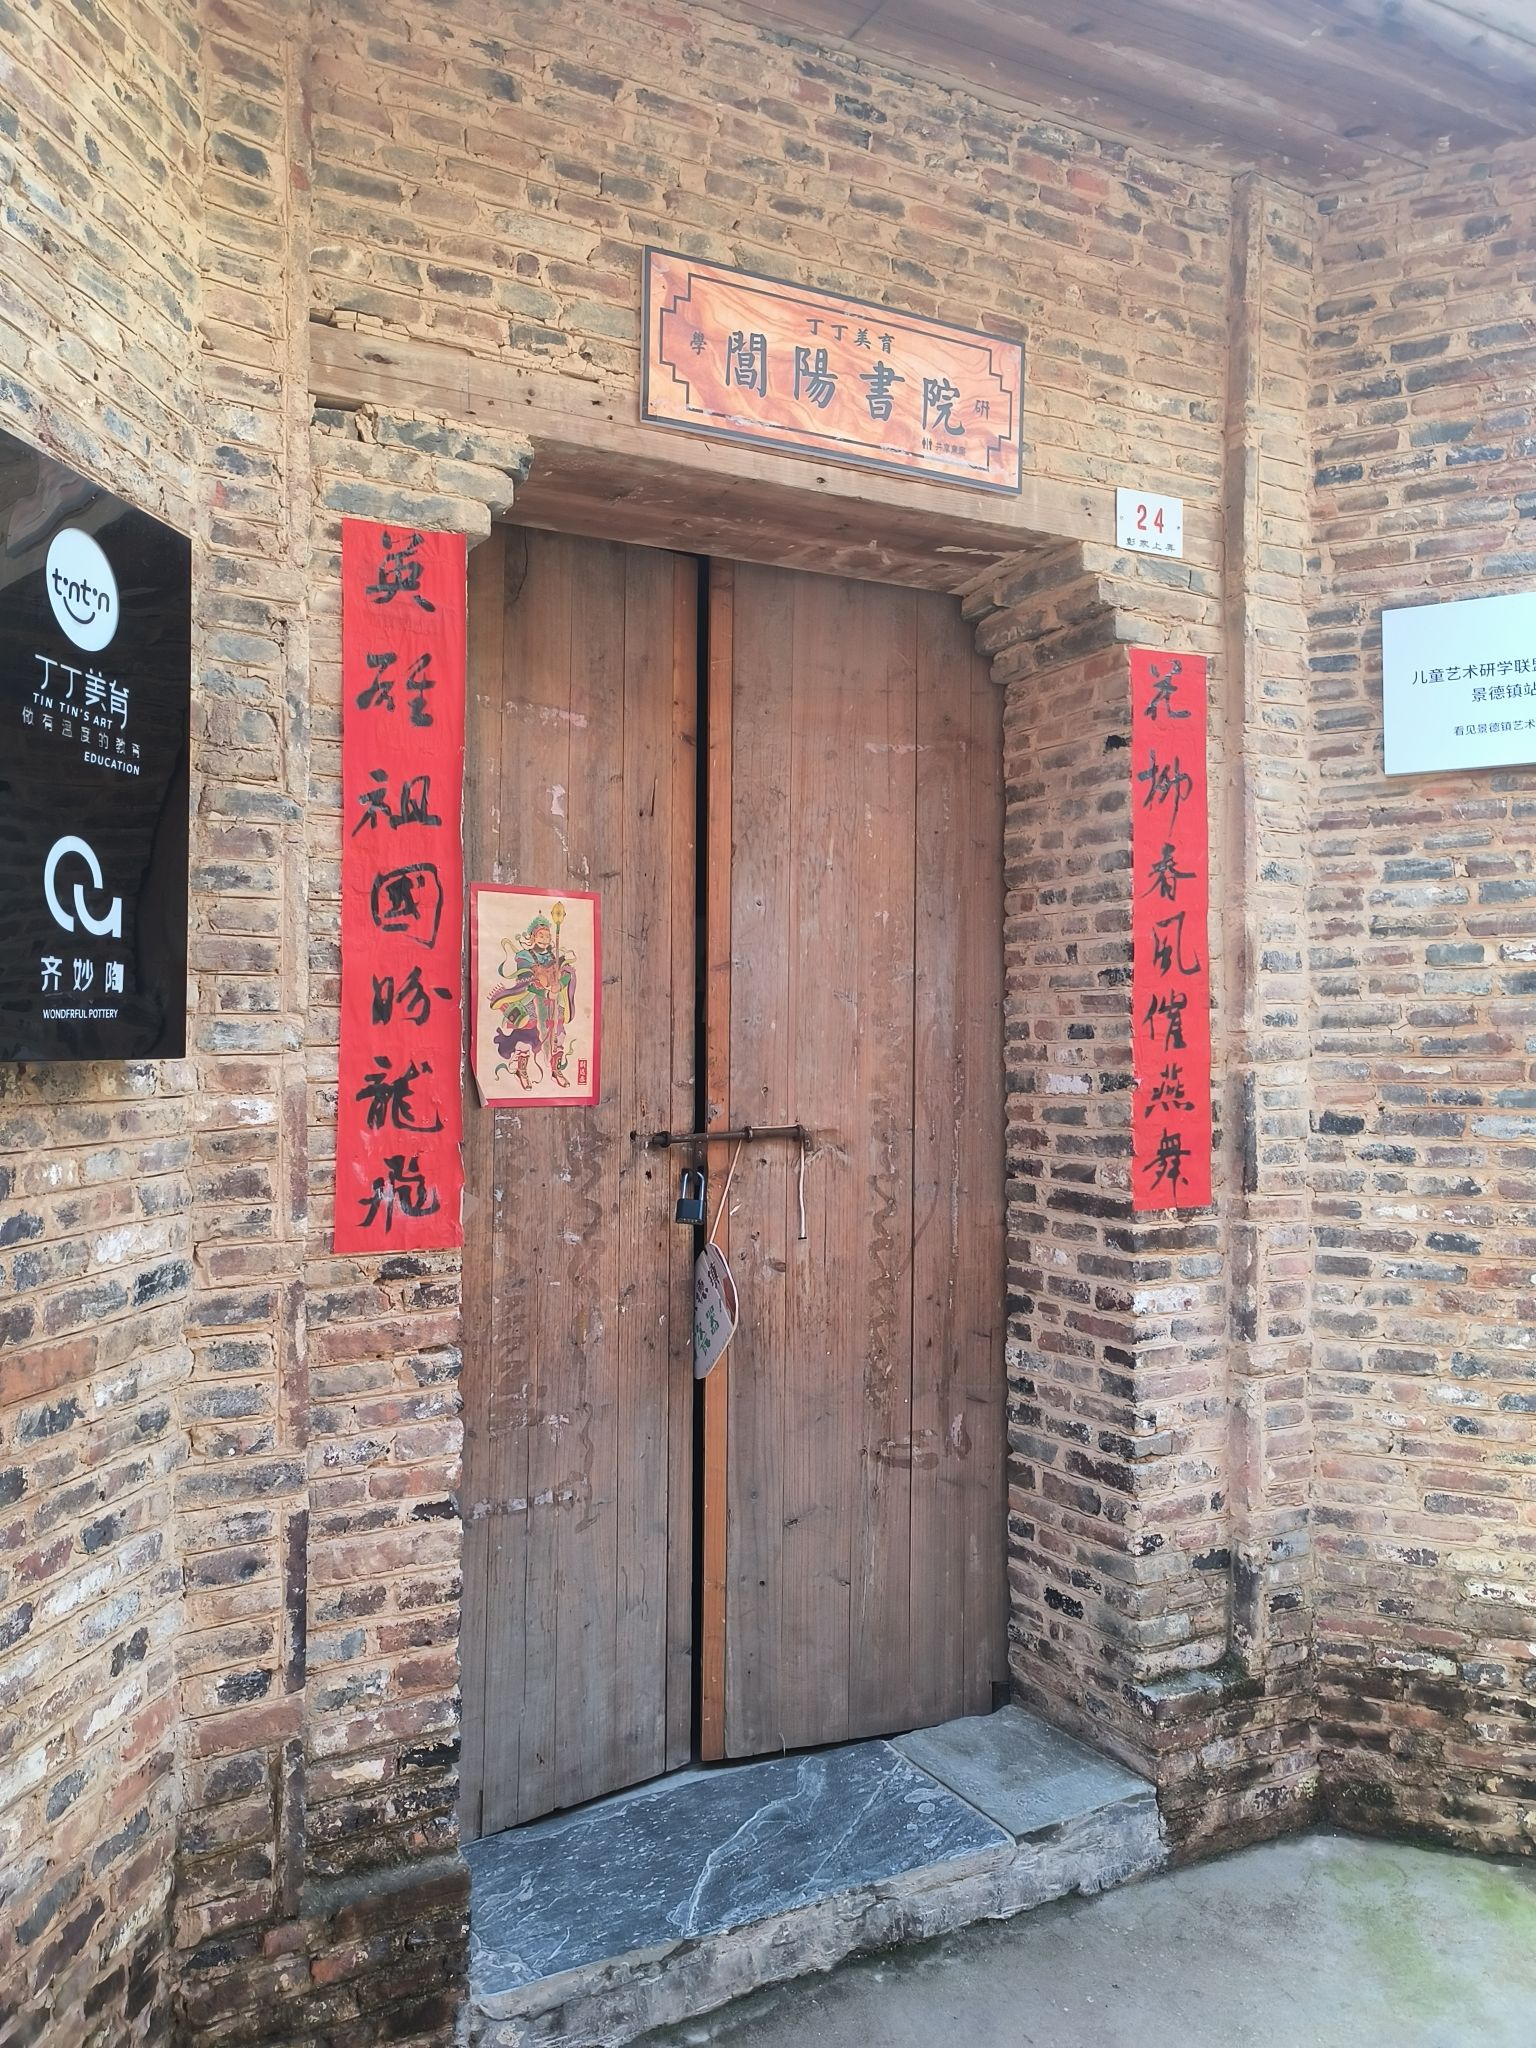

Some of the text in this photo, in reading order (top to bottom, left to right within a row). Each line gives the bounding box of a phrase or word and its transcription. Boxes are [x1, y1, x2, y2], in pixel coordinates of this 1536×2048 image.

[805, 318, 896, 354] 丁丁美育
[1137, 504, 1165, 534] 24
[1412, 656, 1536, 685] 儿童艺术研学联
[34, 653, 130, 730] 丁丁美育
[33, 692, 113, 730] TIN TIN'S ART
[84, 751, 140, 776] EDUCATION
[41, 955, 124, 993] 齐妙陶
[88, 1008, 119, 1019] POTTERY
